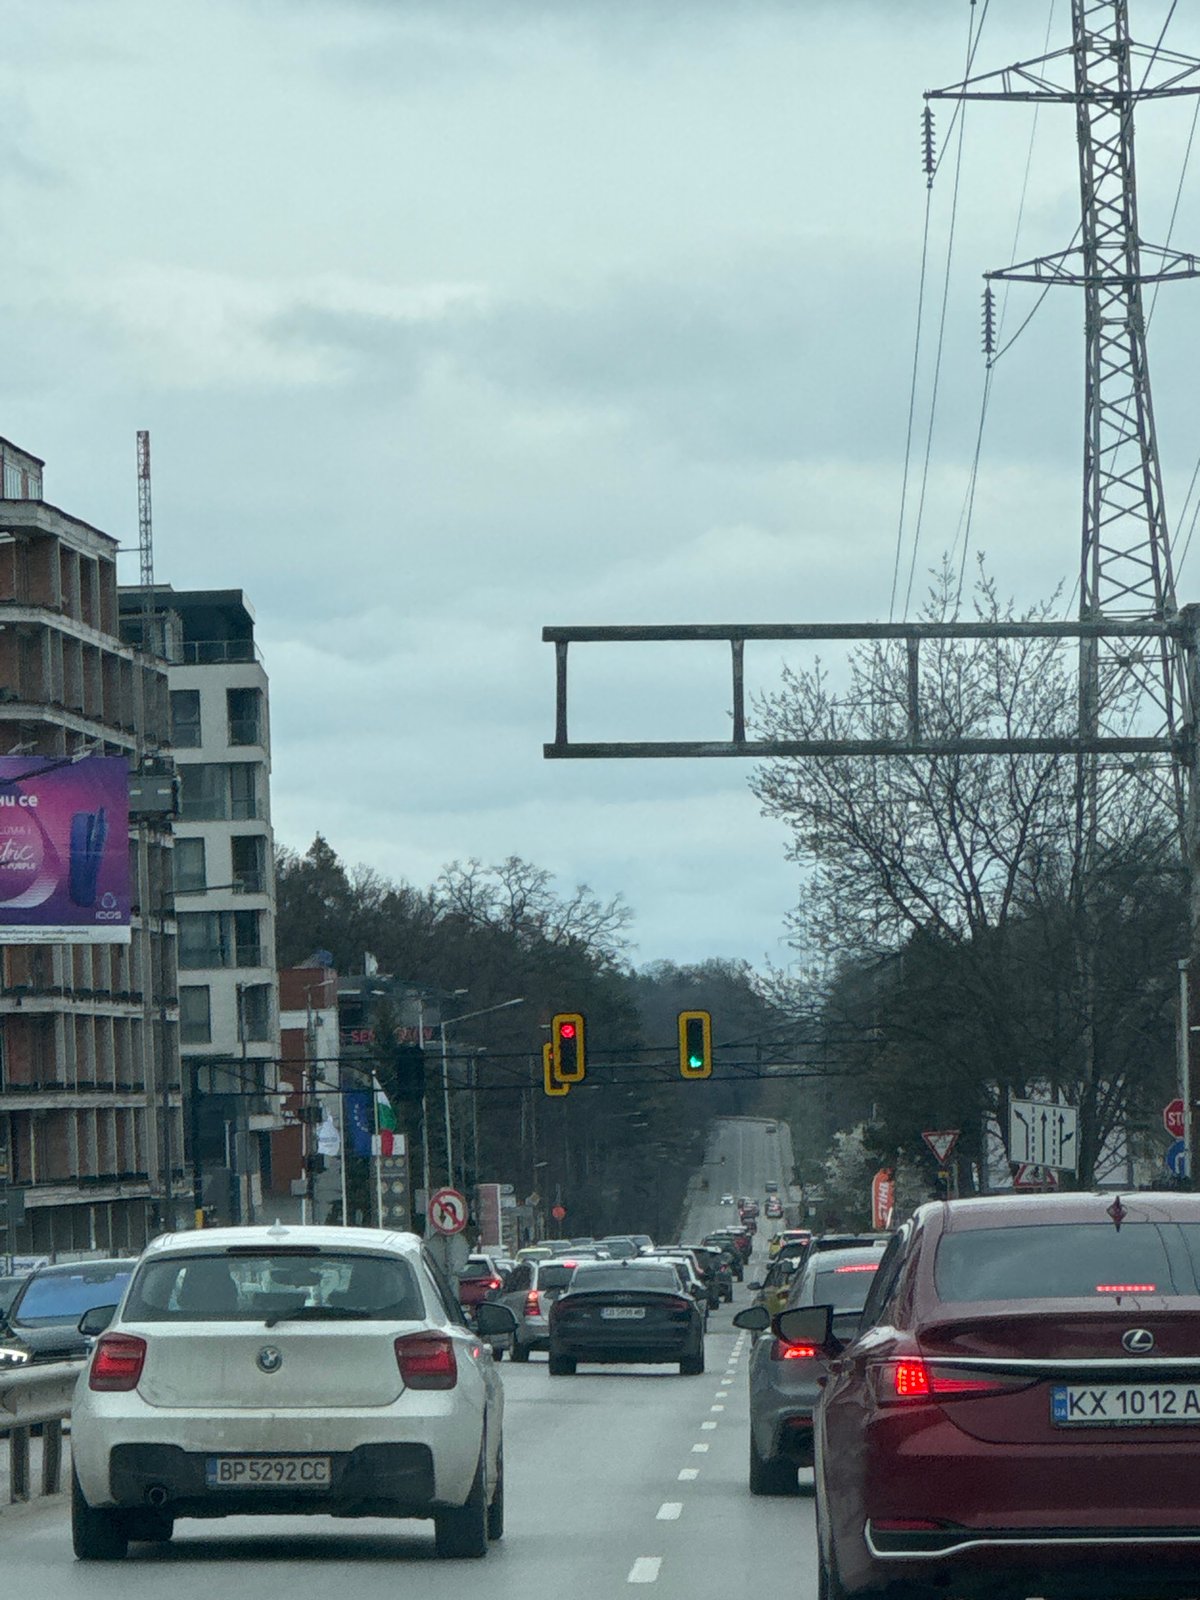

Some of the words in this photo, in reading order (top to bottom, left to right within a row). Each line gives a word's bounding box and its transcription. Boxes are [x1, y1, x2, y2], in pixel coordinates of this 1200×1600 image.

[1168, 1111, 1185, 1126] ST
[1069, 1390, 1107, 1416] KX
[1116, 1389, 1177, 1414] 1012
[1183, 1389, 1200, 1414] A
[1054, 1408, 1066, 1417] UA
[220, 1461, 246, 1481] BP
[249, 1461, 297, 1481] 5292
[301, 1461, 326, 1481] CC
